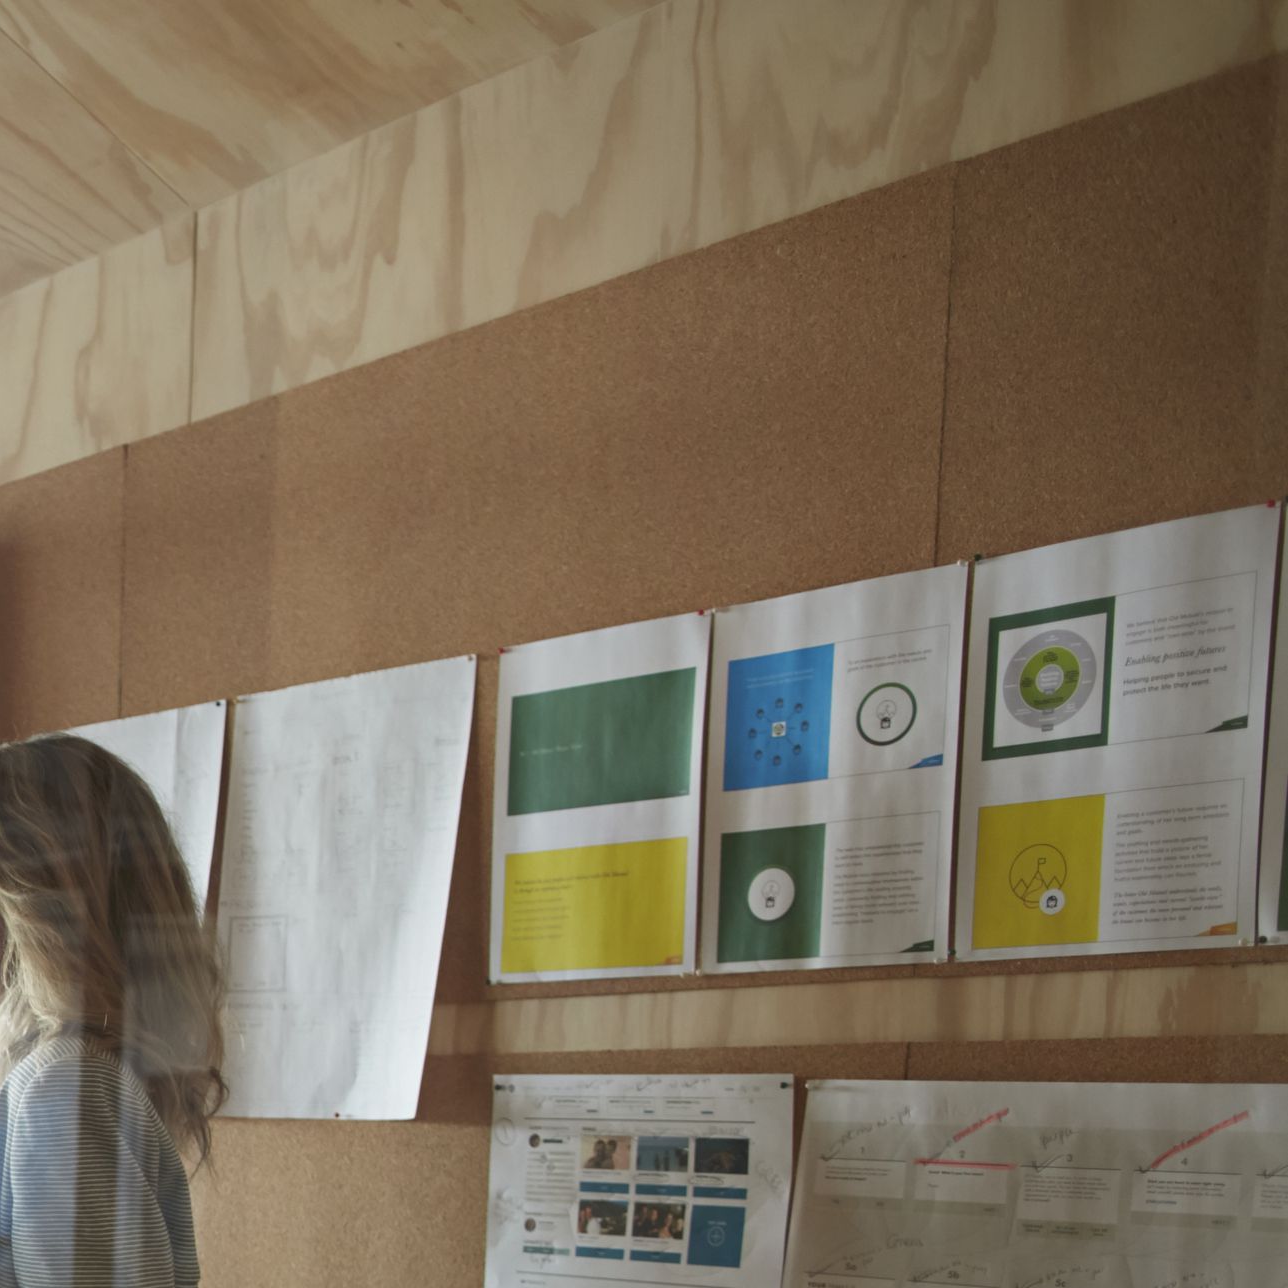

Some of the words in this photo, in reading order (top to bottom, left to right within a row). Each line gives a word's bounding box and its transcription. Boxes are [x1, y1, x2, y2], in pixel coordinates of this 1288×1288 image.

[1125, 655, 1161, 666] Enabling
[1162, 649, 1195, 662] positive
[1194, 646, 1226, 658] futures
[1123, 676, 1149, 685] Helping
[1150, 673, 1175, 682] people
[1186, 667, 1211, 676] secure
[1213, 664, 1228, 672] and
[1123, 686, 1146, 696] protect
[1173, 681, 1190, 689] they
[808, 1281, 827, 1288] YOUR
[1054, 1278, 1067, 1288] 5c
